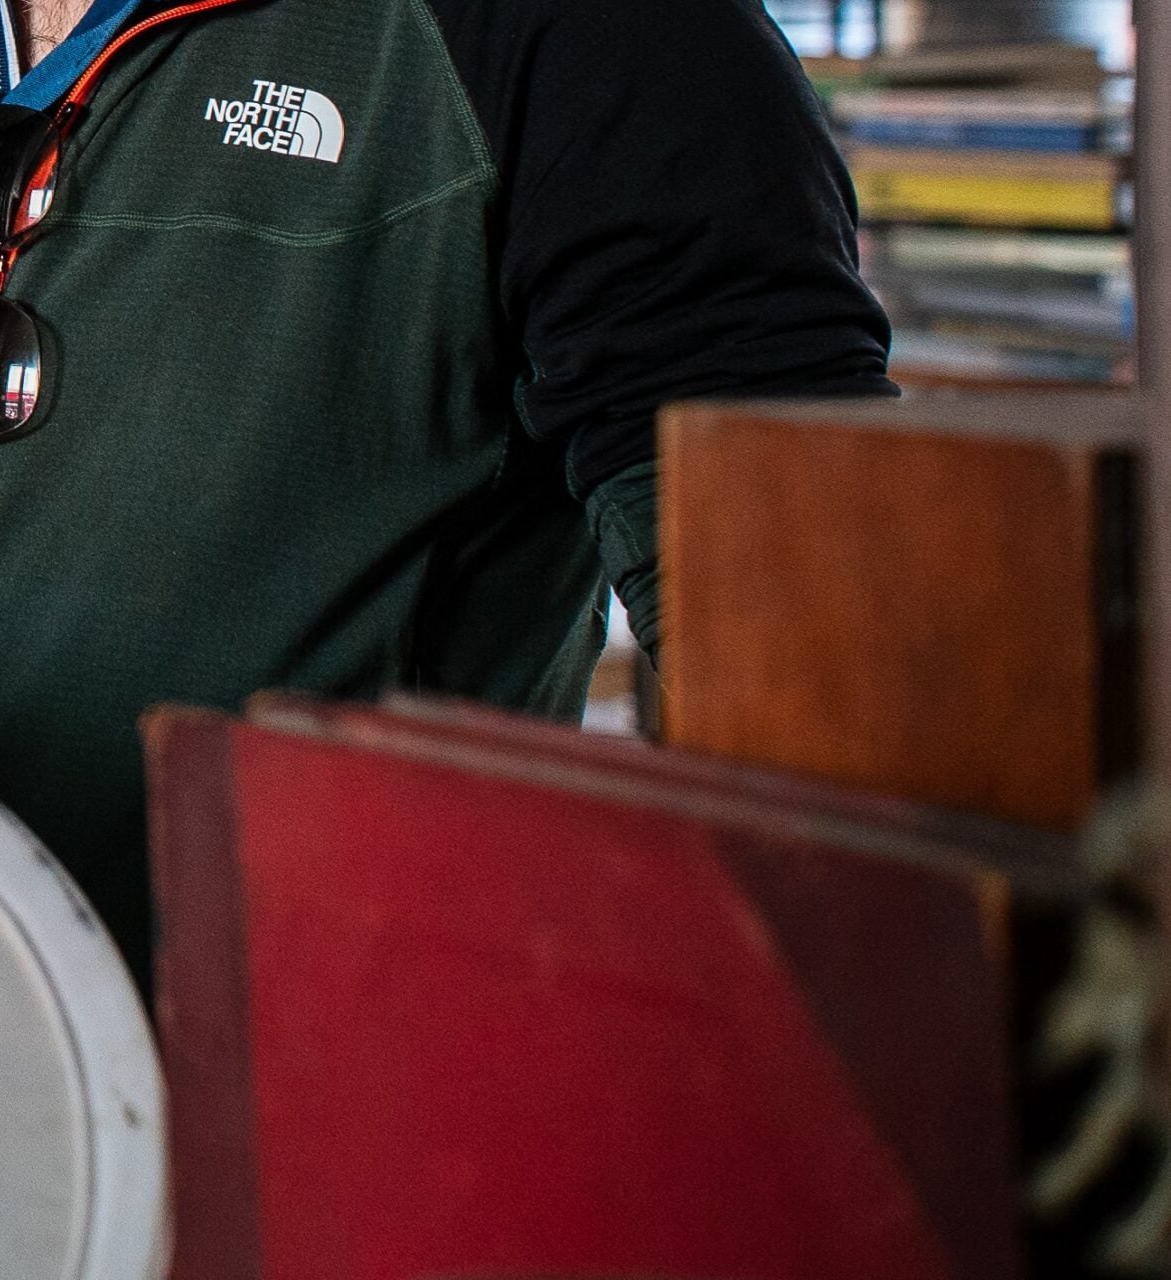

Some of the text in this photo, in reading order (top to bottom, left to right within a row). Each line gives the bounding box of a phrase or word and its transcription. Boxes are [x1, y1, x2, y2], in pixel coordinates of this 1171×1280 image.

[253, 80, 305, 110] THE
[204, 98, 298, 132] NORTH
[223, 123, 292, 154] FACE
